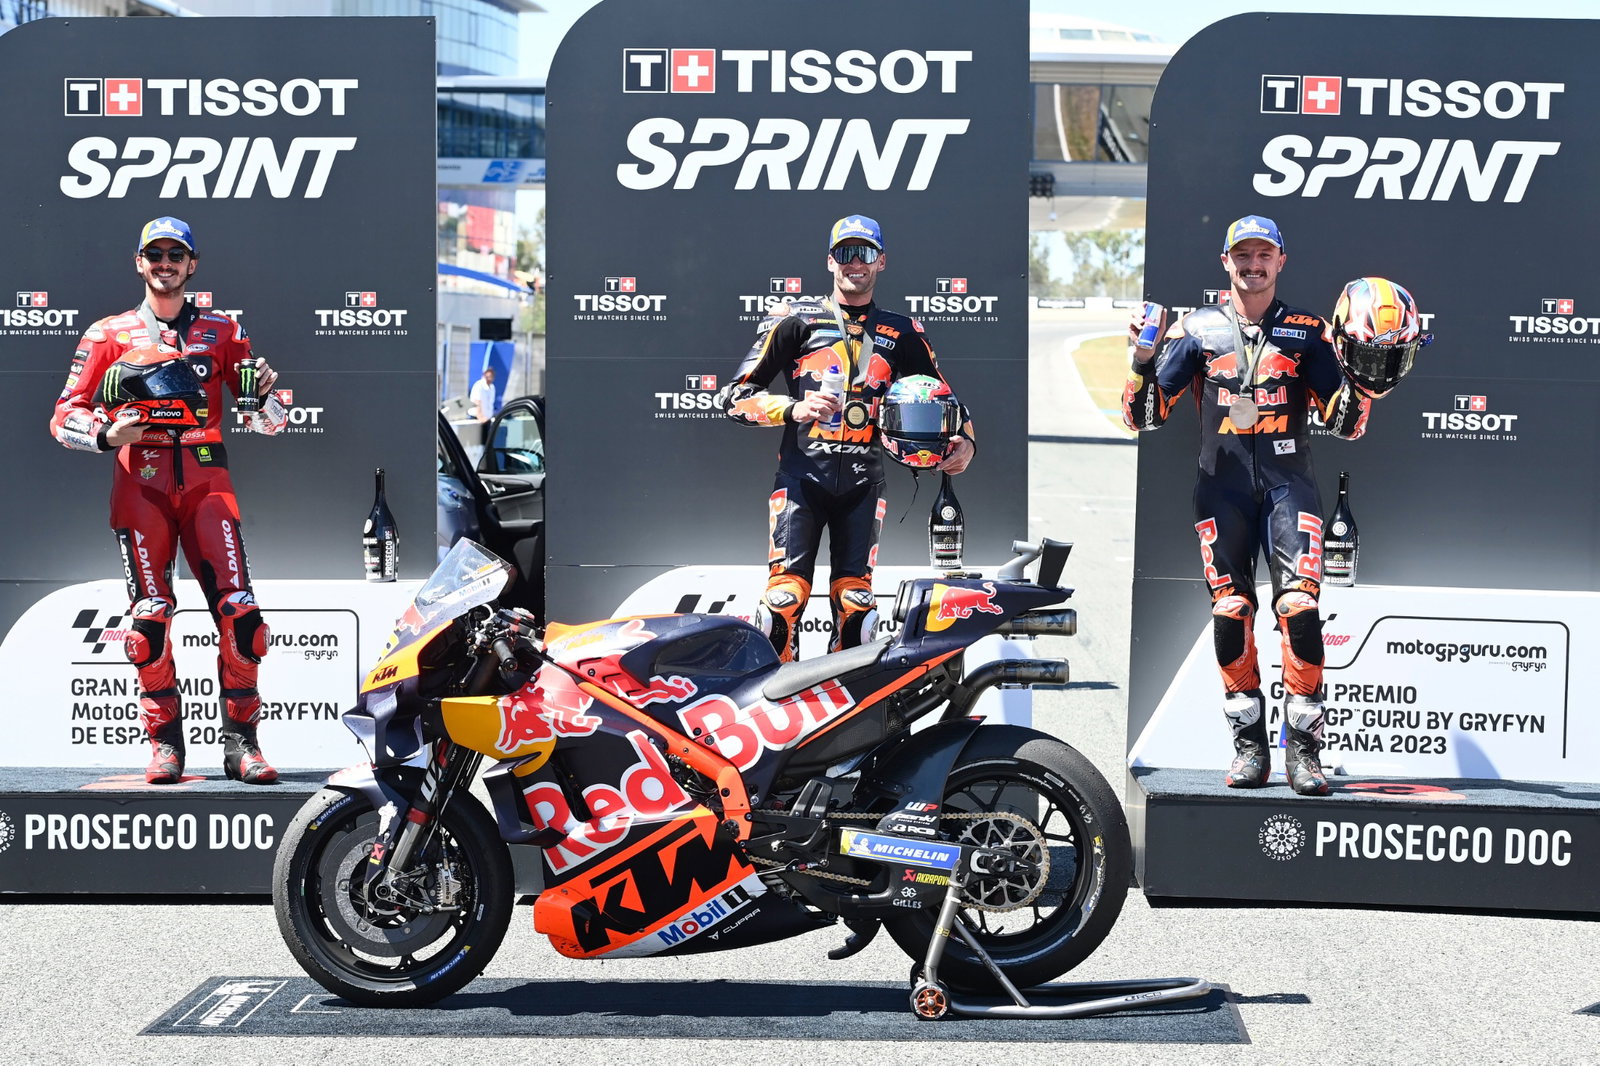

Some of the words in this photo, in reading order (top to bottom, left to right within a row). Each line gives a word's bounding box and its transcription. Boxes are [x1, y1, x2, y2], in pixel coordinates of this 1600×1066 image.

[722, 49, 973, 94] TISSOT
[148, 79, 359, 116] TISSOT
[1347, 78, 1565, 120] TISSOT
[617, 118, 971, 191] SPRINT
[60, 137, 357, 199] SPRINT
[1253, 134, 1561, 203] SPRINT
[574, 295, 667, 312] TISSOT
[905, 296, 998, 313] TISSOT
[315, 310, 407, 326] TISSOT
[1283, 314, 1319, 327] KTM
[1273, 329, 1298, 338] Mobil
[655, 393, 724, 409] TISS
[1217, 387, 1243, 406] Re
[1255, 386, 1288, 406] Bull
[151, 409, 181, 418] Lenovo
[1422, 412, 1517, 431] TISSOT
[1195, 517, 1233, 589] Red
[1296, 511, 1324, 584] Bull
[119, 535, 137, 599] Lenovo
[1386, 639, 1547, 662] motogpguru.com
[372, 665, 398, 683] KTM
[71, 679, 127, 696] GRAN
[1334, 684, 1417, 704] PREMIO
[71, 703, 138, 721] MotoG
[260, 703, 339, 721] GRYFYN
[1362, 708, 1420, 730] GURU
[1427, 711, 1453, 730] BY
[1459, 712, 1545, 733] GRYFYN
[71, 727, 97, 744] DE
[103, 727, 156, 744] ESPA
[190, 727, 226, 745] 202
[1390, 734, 1447, 754] 2023
[523, 730, 693, 876] Red
[676, 678, 857, 773] Bull
[320, 796, 351, 820] MICHELIN
[904, 801, 939, 813] WP
[25, 813, 197, 850] PROSECCO
[209, 813, 274, 850] DOC
[907, 826, 936, 836] RCB
[873, 843, 949, 862] MICHELIN
[1315, 821, 1493, 864] PROSECCO
[1504, 828, 1572, 867] DOC
[570, 819, 750, 954] KTM
[916, 872, 951, 886] AKRAPOV
[892, 898, 922, 909] GILLES
[657, 902, 727, 946] Mobil
